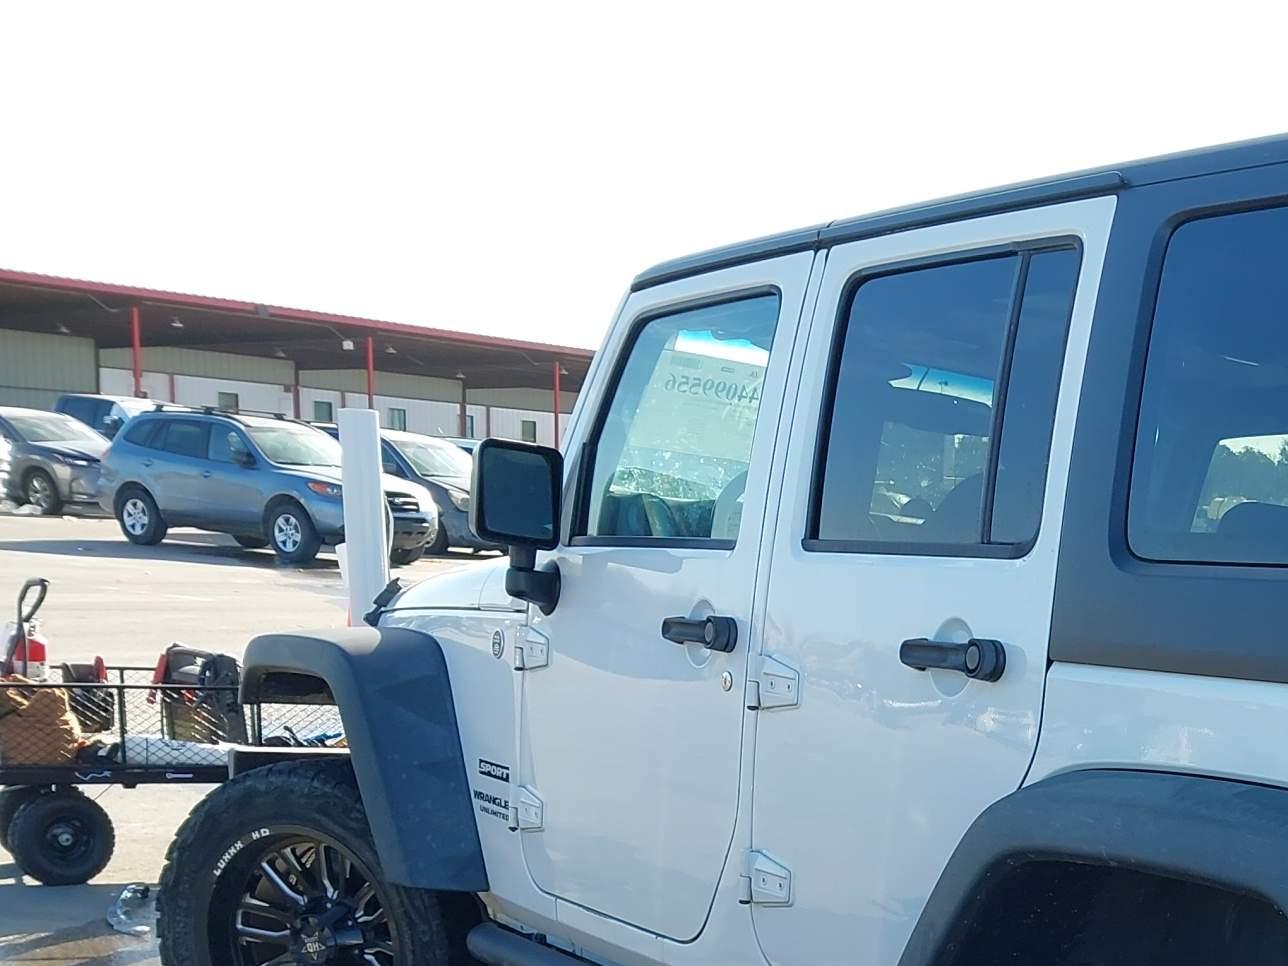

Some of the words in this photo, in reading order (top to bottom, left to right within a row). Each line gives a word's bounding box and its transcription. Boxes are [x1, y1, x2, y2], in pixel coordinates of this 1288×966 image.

[479, 761, 510, 780] SPORT
[479, 805, 510, 822] UNLIMITED
[213, 840, 244, 876] LUXXX
[251, 828, 271, 840] HD
